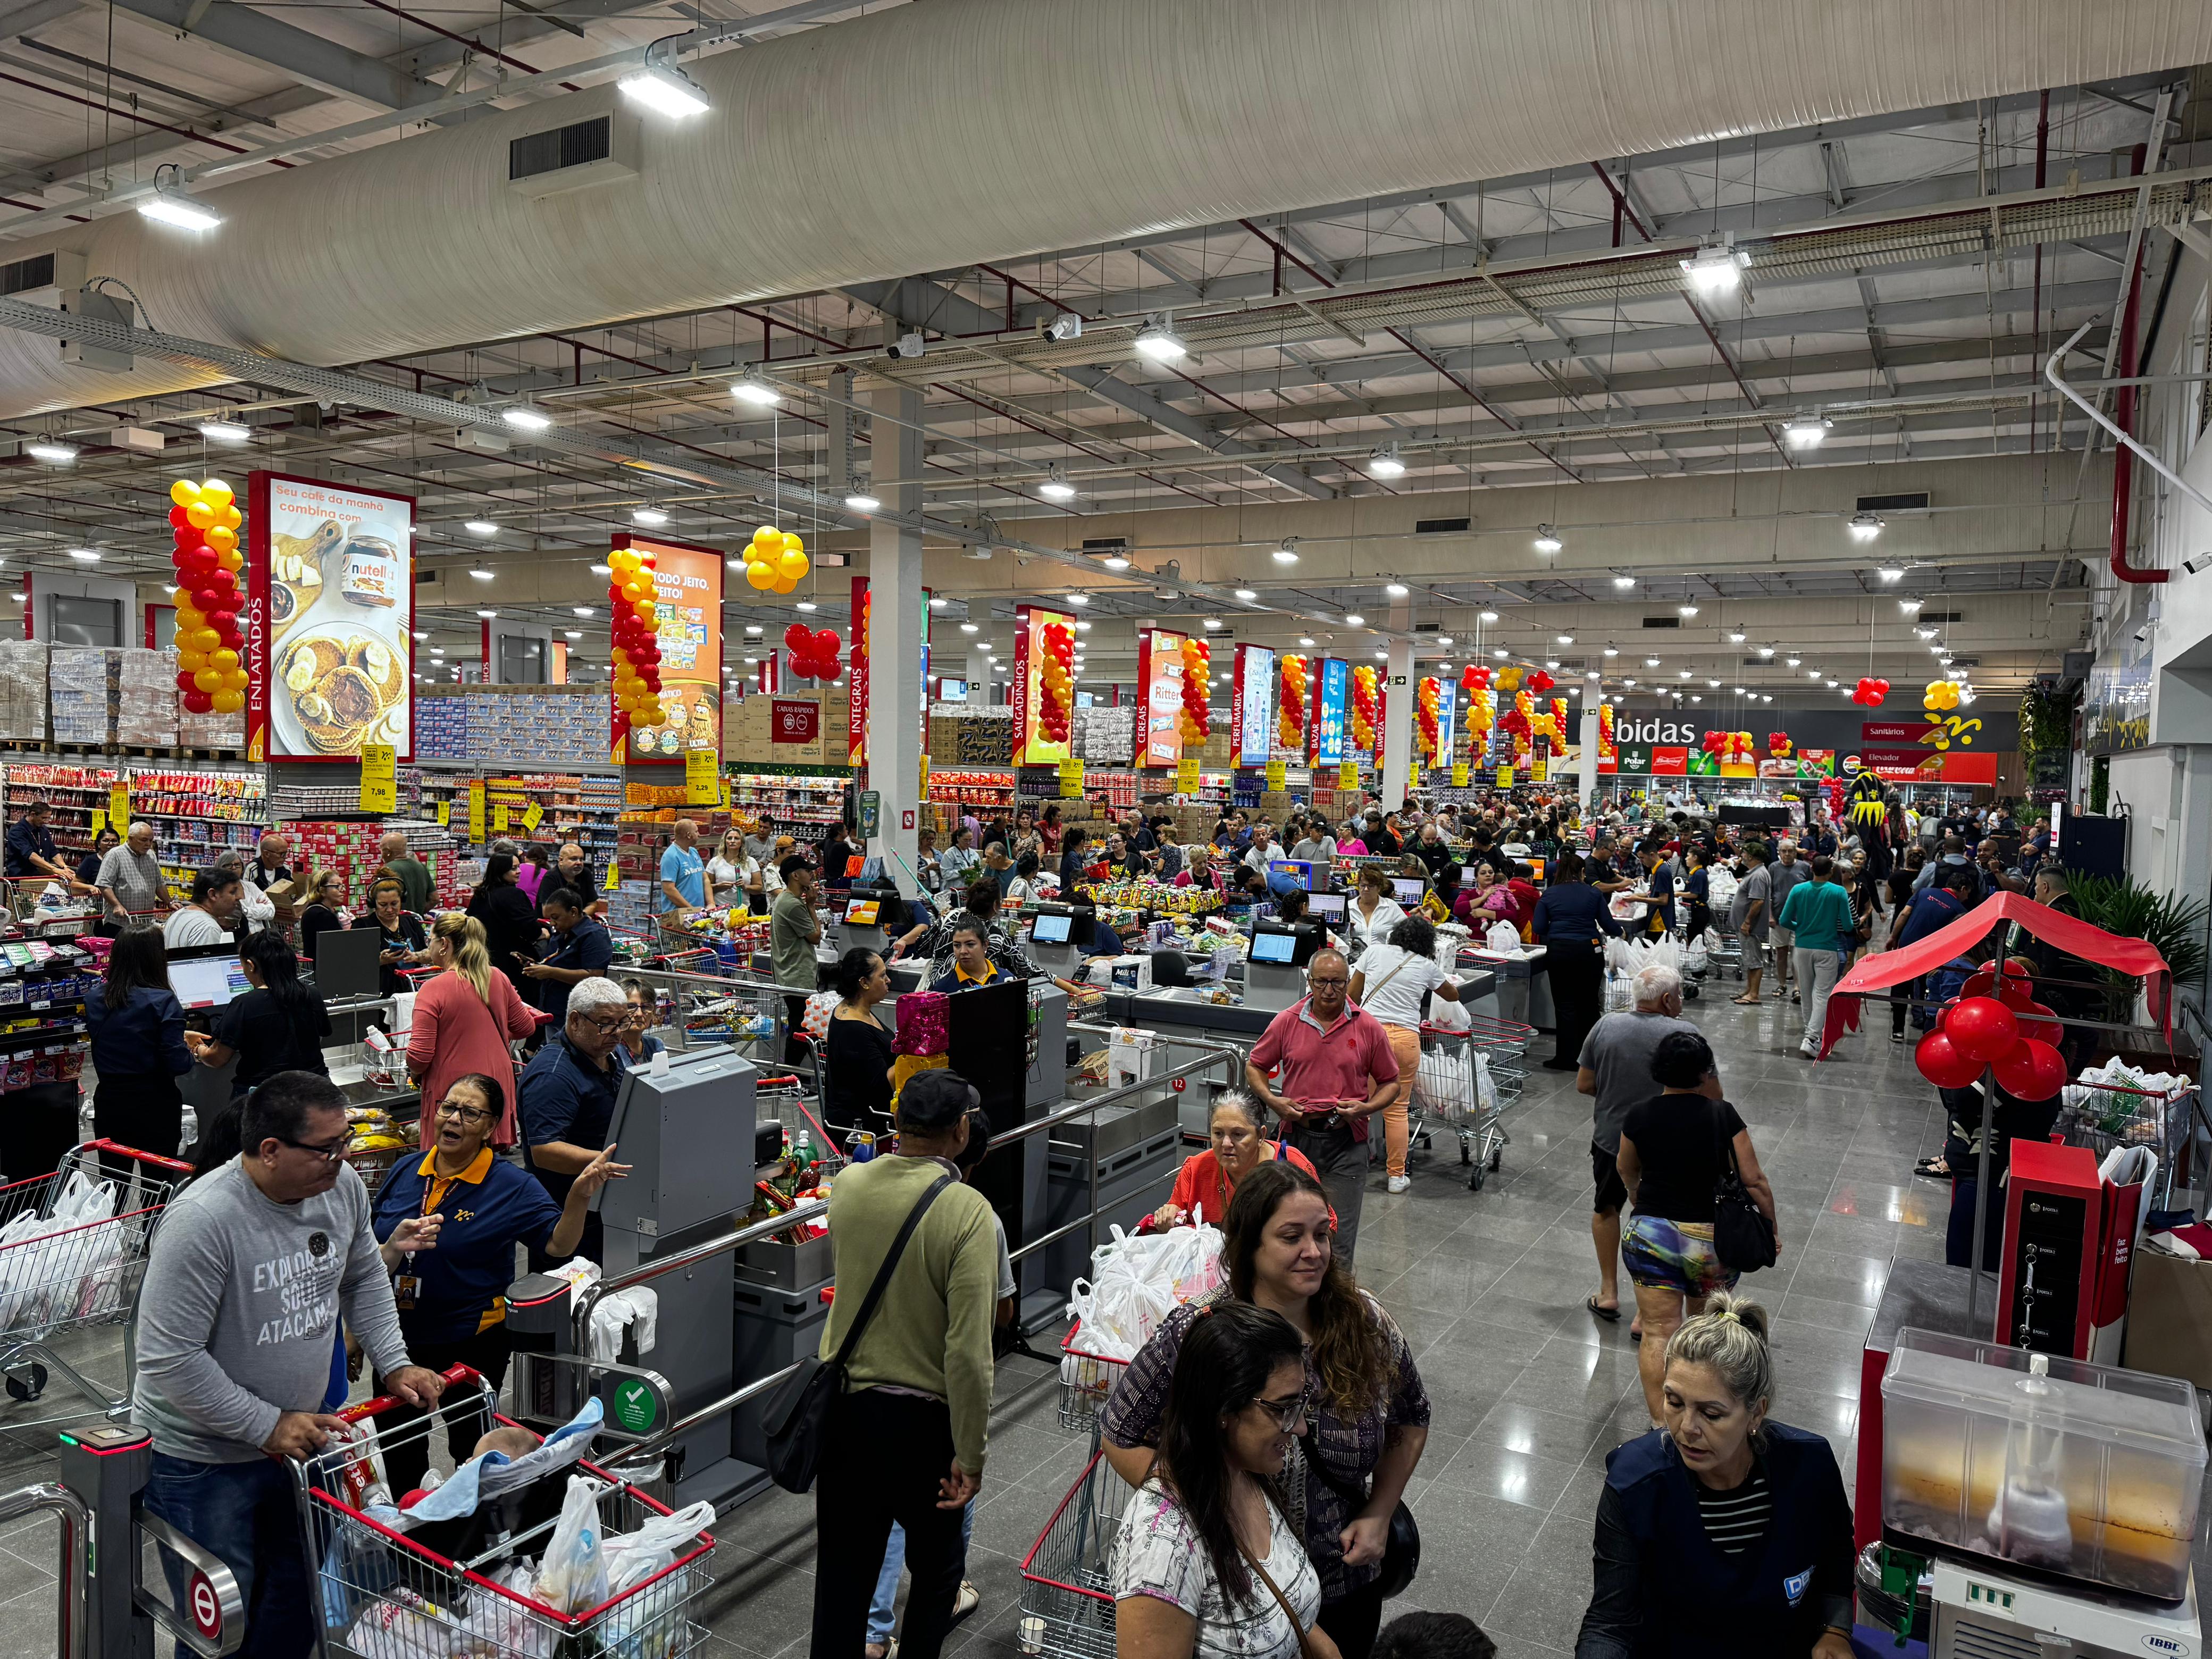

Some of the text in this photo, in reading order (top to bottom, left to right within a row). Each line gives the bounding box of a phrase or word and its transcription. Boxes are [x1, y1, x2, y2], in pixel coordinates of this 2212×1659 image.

[276, 485, 384, 511] Seu café da manhã
[280, 502, 362, 522] combina com
[352, 564, 394, 581] nutella
[652, 572, 709, 591] TODO JEITO,
[251, 597, 262, 710] ENLATADOS
[852, 668, 862, 733] INTEGRAIS
[1015, 660, 1025, 739] SALGADINHOS
[1155, 686, 1180, 700] Ritter
[794, 706, 815, 714] RÁPIDOS
[1233, 692, 1242, 747] PERFUMARIA
[1137, 705, 1146, 743] CEREAIS
[1613, 718, 1696, 743] bidas
[253, 744, 263, 759] 12
[615, 750, 624, 762] 11
[852, 755, 861, 765] 10
[1624, 757, 1646, 766] Polar
[2117, 1238, 2126, 1247] faz
[2115, 1256, 2127, 1264] feito
[345, 1451, 366, 1492] etto
